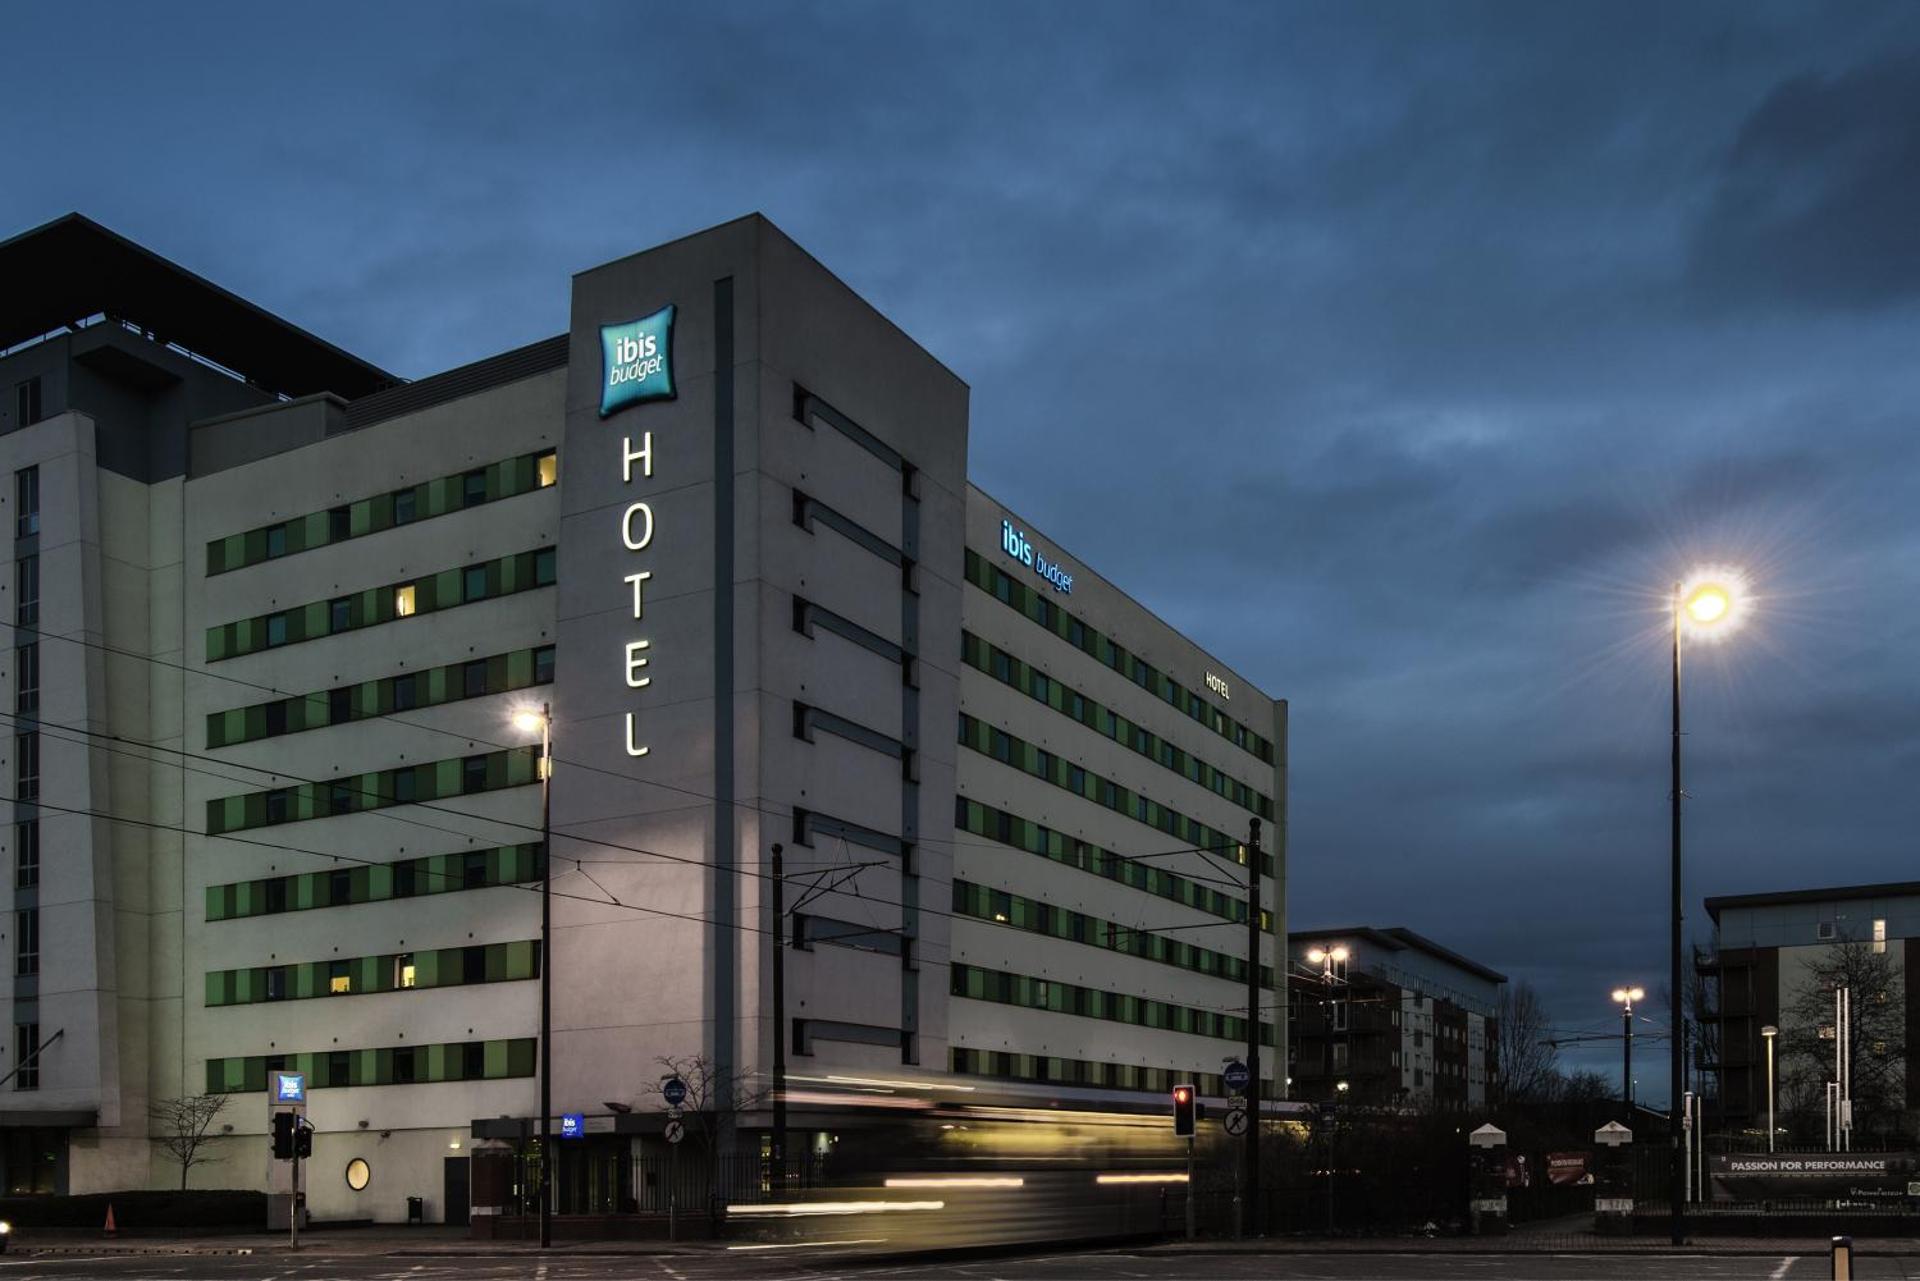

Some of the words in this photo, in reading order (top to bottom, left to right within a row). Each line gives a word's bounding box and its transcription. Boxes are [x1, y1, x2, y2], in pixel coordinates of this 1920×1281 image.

[616, 332, 657, 365] ibis
[610, 354, 664, 386] budget
[1003, 520, 1032, 566] ibis
[1036, 552, 1073, 593] budget
[622, 432, 654, 757] HOTEL
[1206, 671, 1230, 700] HOTEL
[1731, 1162, 1778, 1171] PASSION
[1780, 1162, 1803, 1170] FOR
[1804, 1161, 1886, 1170] PERFORMANCE
